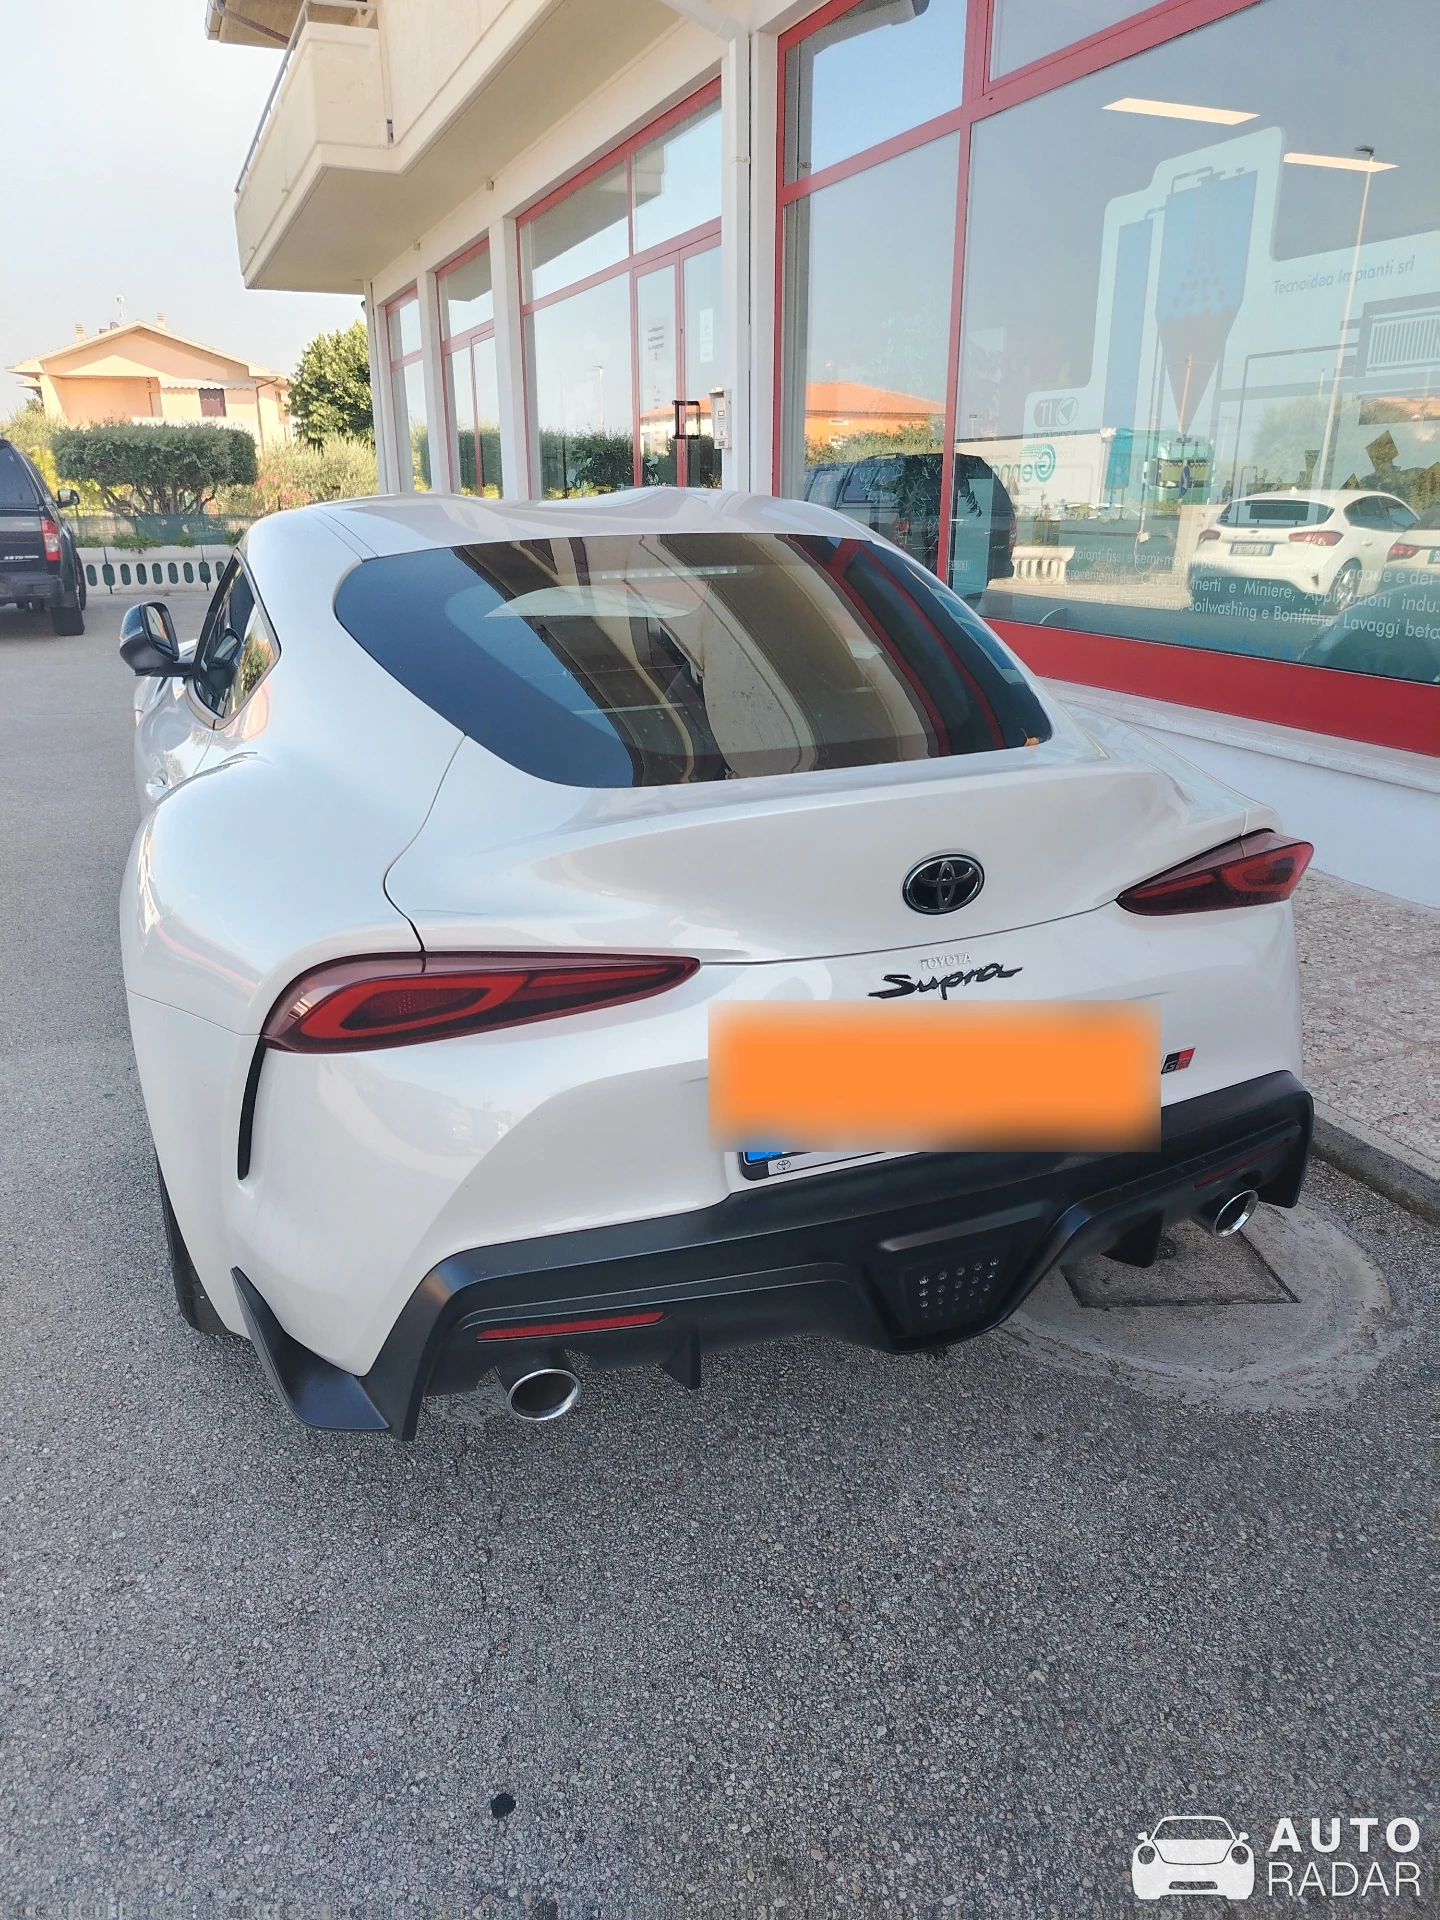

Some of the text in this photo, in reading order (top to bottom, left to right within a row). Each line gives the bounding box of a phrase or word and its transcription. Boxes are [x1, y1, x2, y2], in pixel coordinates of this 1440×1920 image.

[1273, 254, 1416, 296] Tecnoidea Impianti srl
[1068, 547, 1105, 564] mpianti
[1106, 547, 1125, 563] fissi
[1127, 555, 1133, 563] e
[1348, 569, 1392, 585] acque
[1396, 573, 1405, 584] e
[1409, 568, 1433, 586] dei
[1140, 571, 1168, 587] Cave
[1174, 572, 1185, 589] di
[1192, 575, 1222, 593] inerti
[1228, 582, 1237, 594] e
[1243, 579, 1296, 602] Miniere,
[1304, 587, 1391, 609] Applazioni
[1188, 597, 1257, 622] Soilwashing
[1261, 608, 1269, 620] e
[1273, 605, 1337, 631] Bonifiche,
[1343, 612, 1401, 638] Lavaggi
[918, 951, 972, 972] TOYOTA
[866, 962, 1024, 1000] Supra
